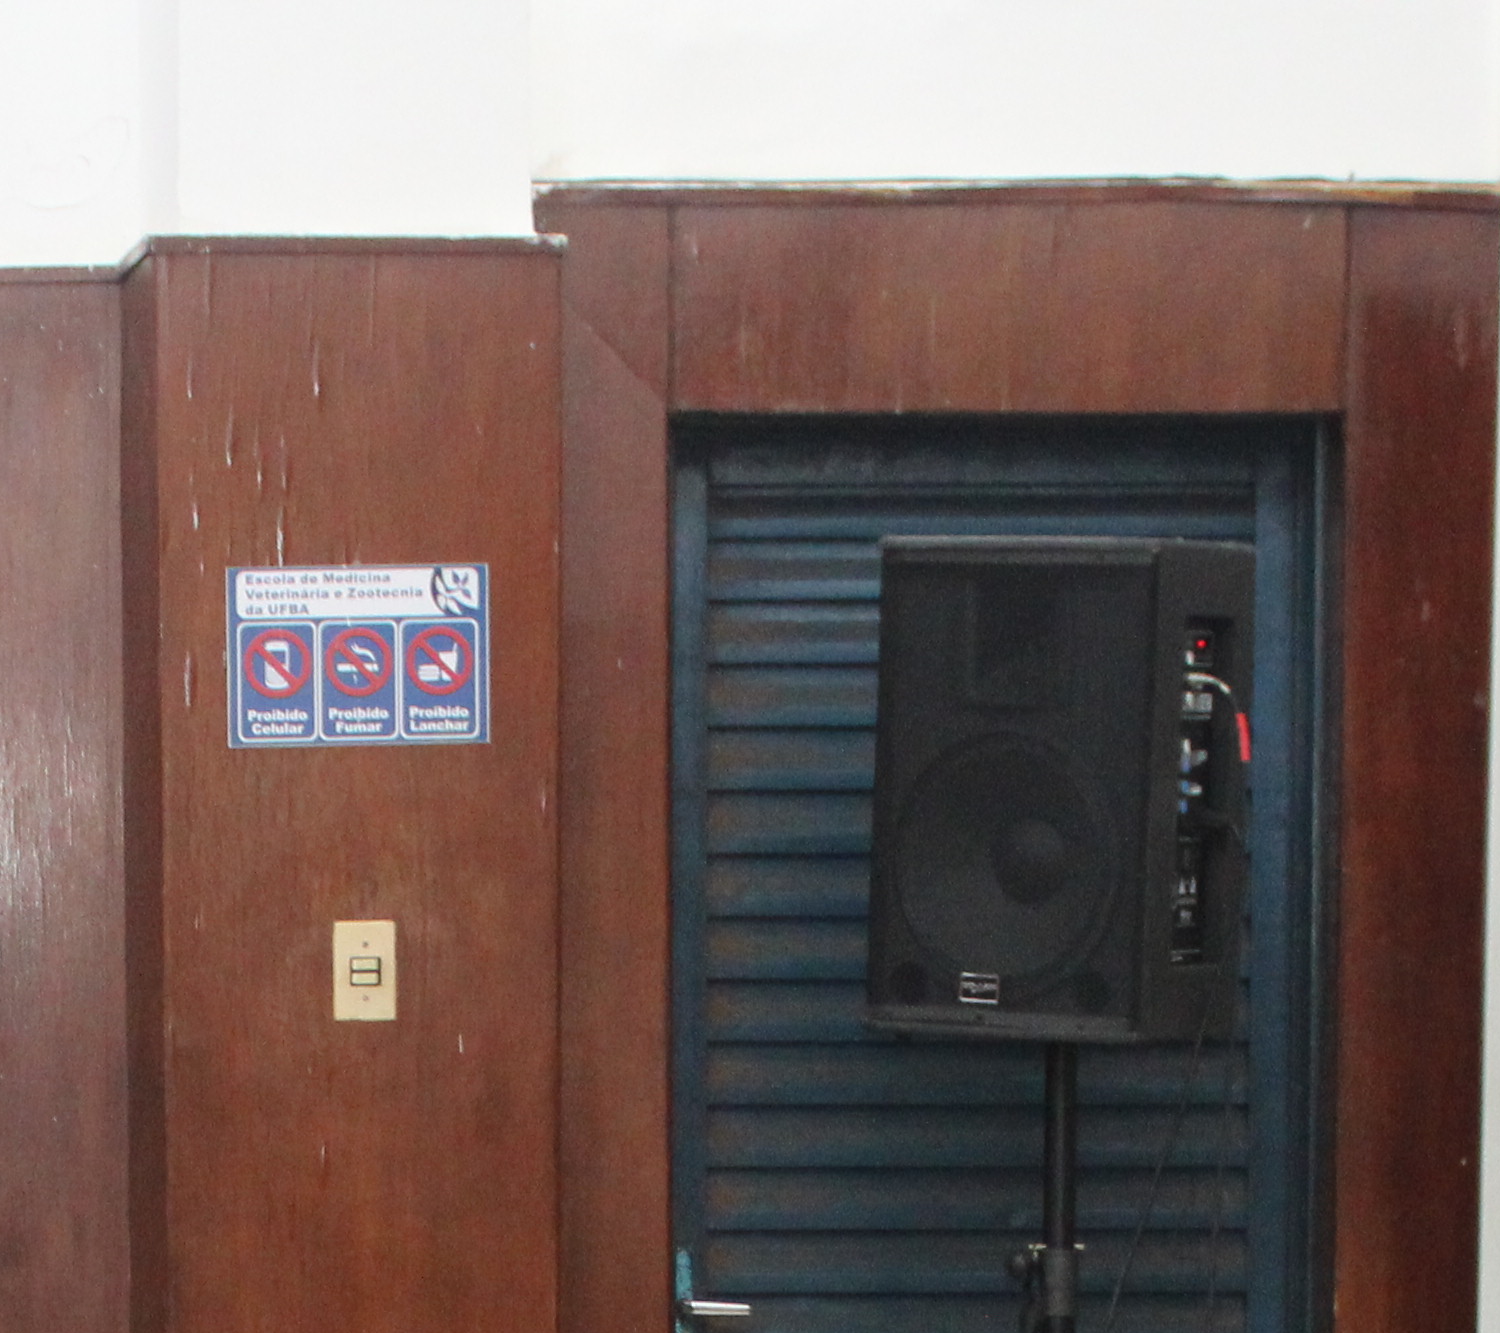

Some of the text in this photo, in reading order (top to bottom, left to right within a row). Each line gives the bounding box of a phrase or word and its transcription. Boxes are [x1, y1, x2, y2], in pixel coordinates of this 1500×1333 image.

[245, 572, 391, 585] Escola de Medicina
[245, 586, 329, 600] Veterinária
[348, 585, 423, 598] Zootecnia
[245, 603, 309, 615] da UFBA
[247, 708, 308, 722] Proibido
[328, 707, 389, 721] Proibido
[409, 705, 470, 718] Proibido
[251, 721, 304, 735] Celular
[336, 719, 383, 733] Fumar
[410, 719, 470, 732] Lanchar
